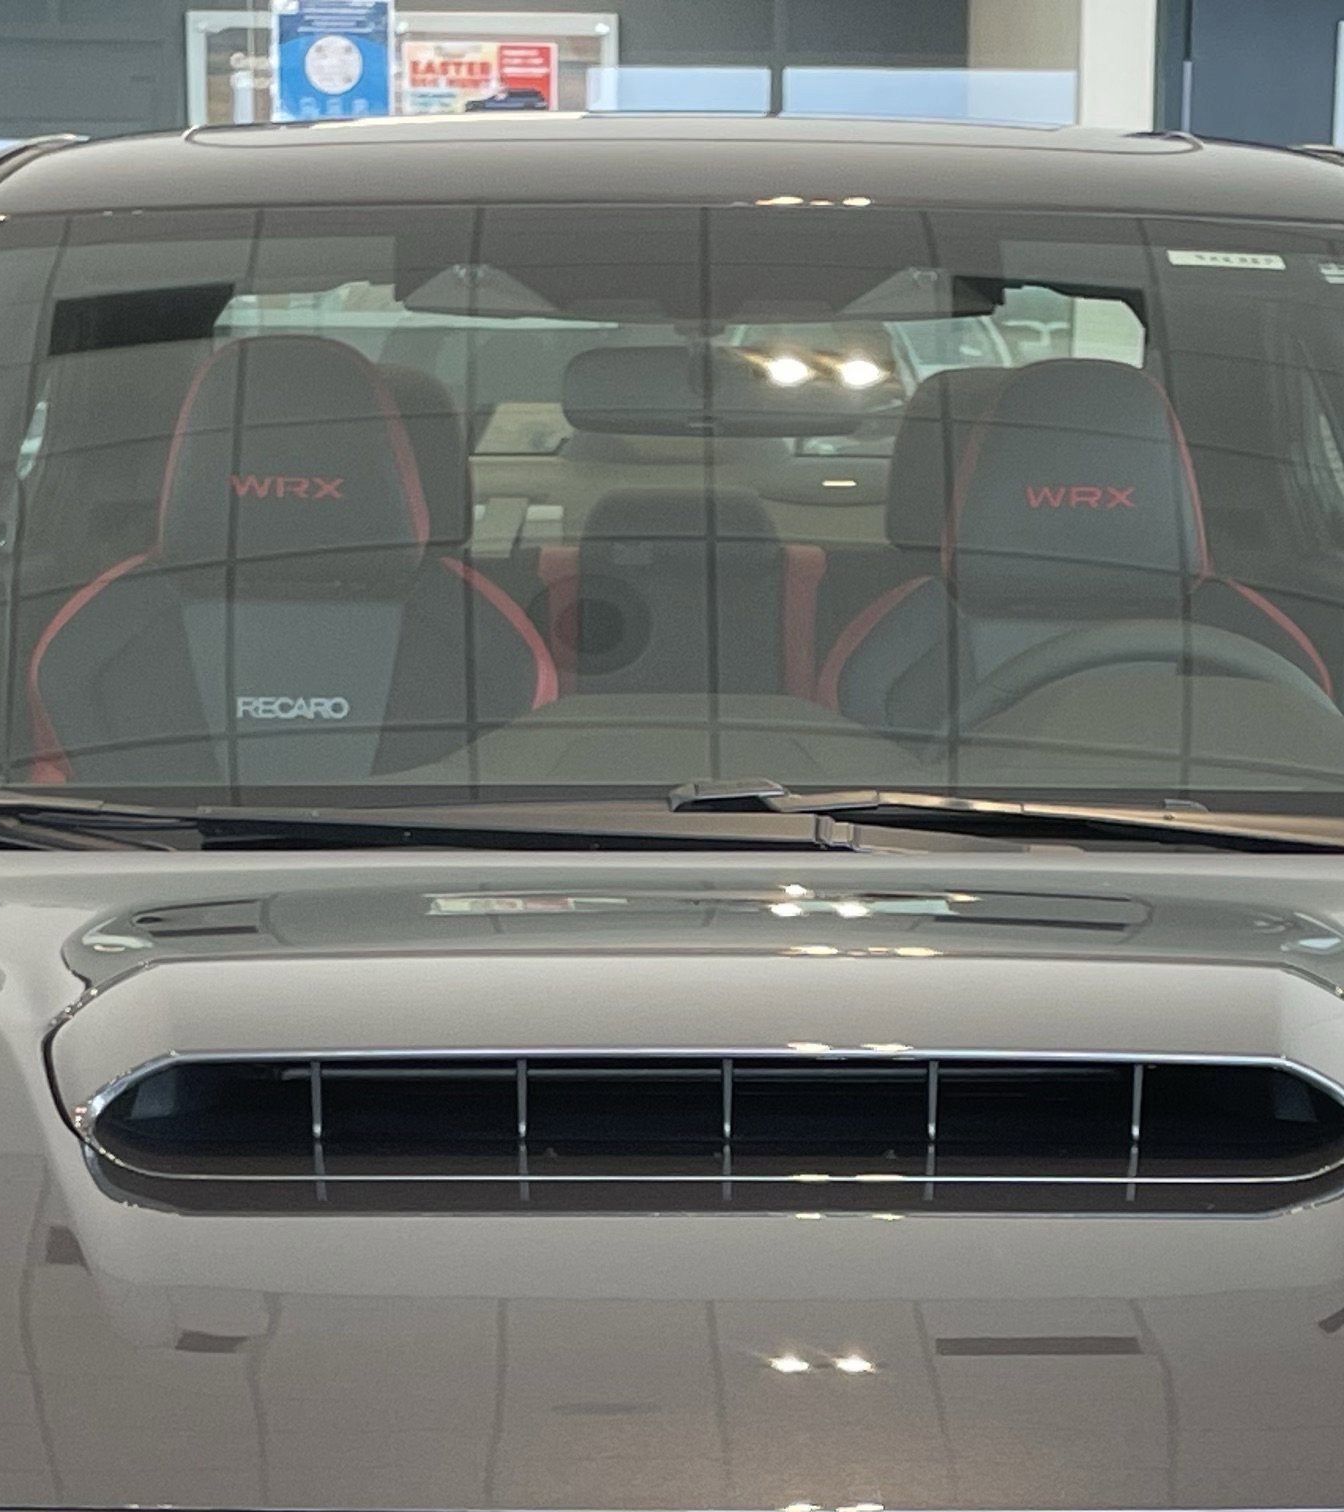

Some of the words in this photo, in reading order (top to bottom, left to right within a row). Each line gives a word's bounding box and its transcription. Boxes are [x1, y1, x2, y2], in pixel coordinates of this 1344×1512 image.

[229, 474, 344, 498] WRX
[1024, 484, 1136, 510] WRX
[236, 696, 350, 719] RECARO
